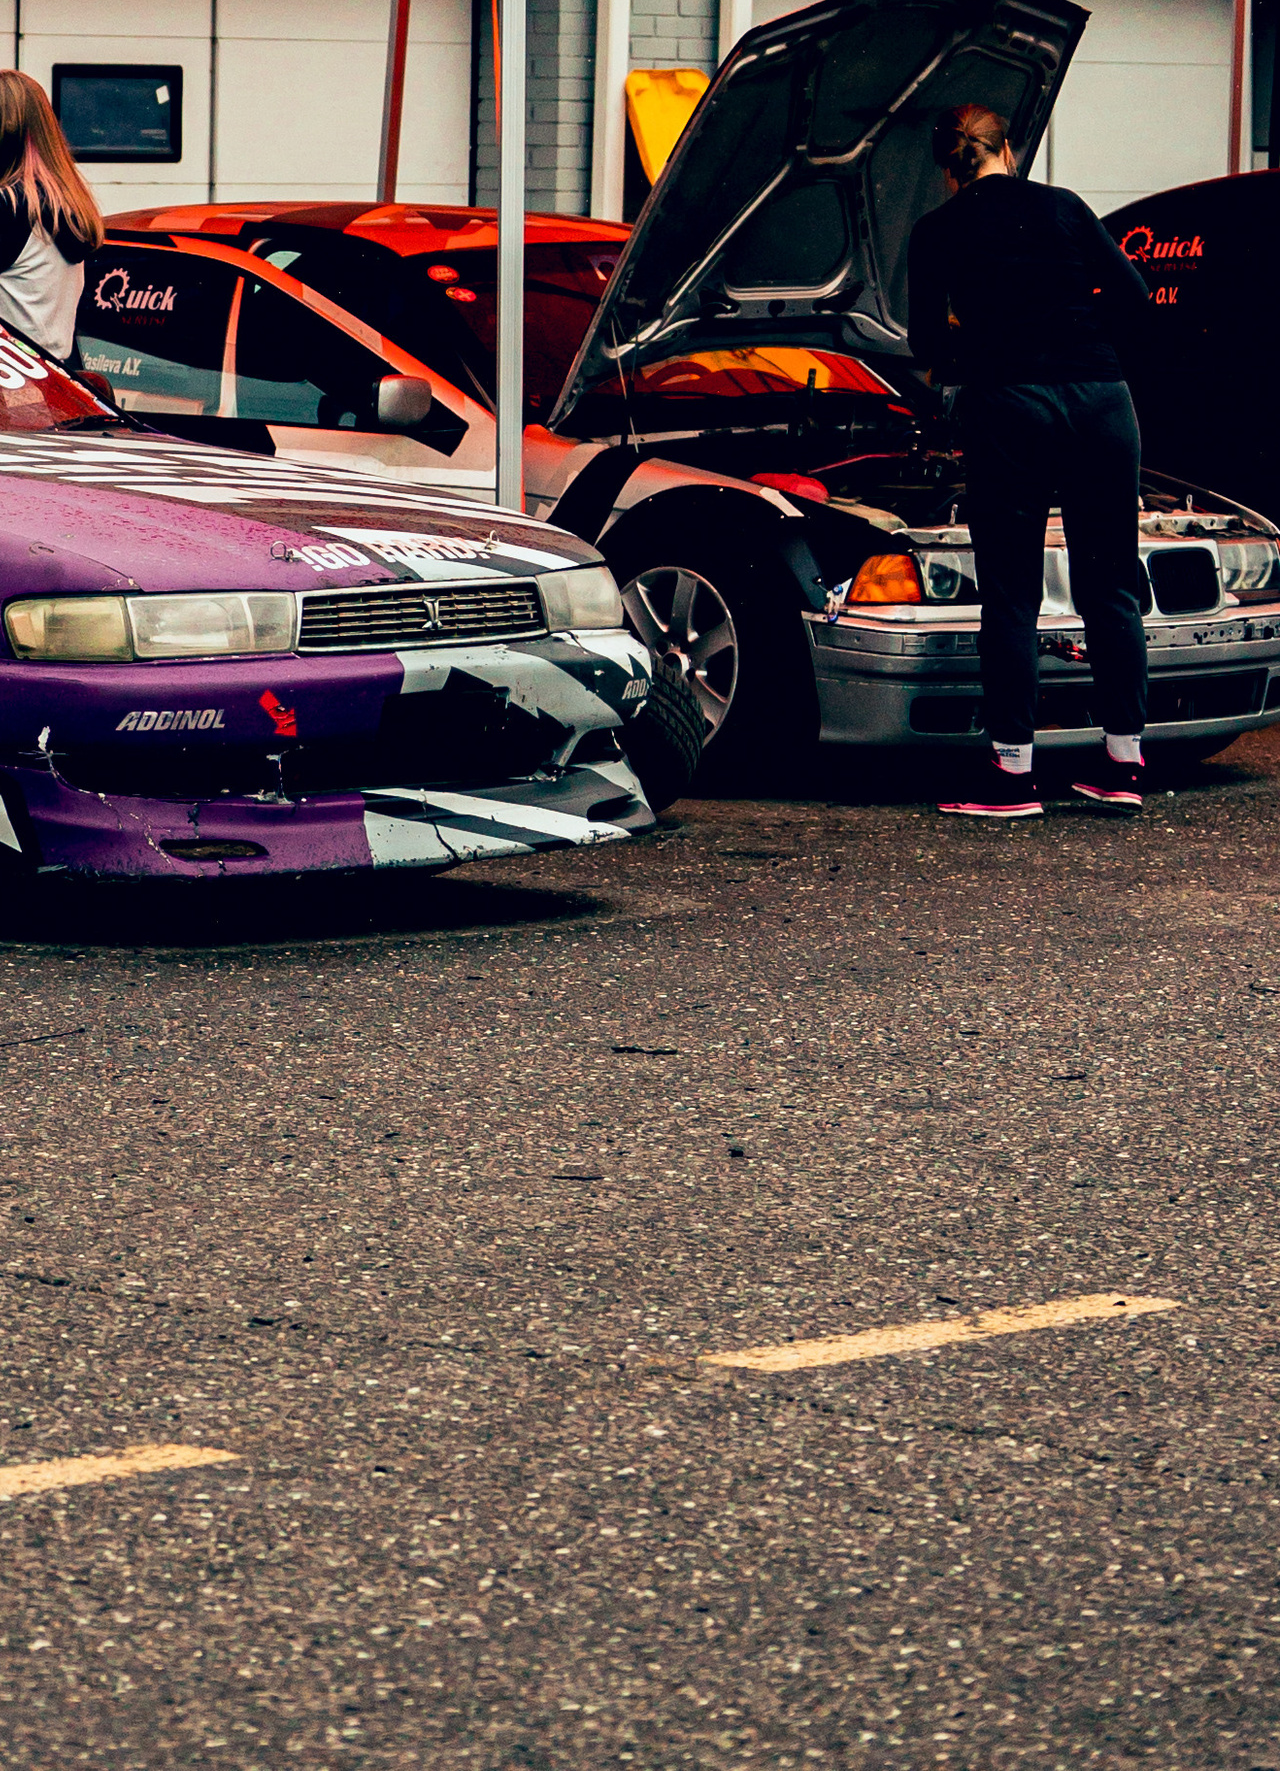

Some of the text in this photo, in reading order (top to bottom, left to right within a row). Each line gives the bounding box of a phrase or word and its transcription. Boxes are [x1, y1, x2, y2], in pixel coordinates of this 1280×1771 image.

[1118, 225, 1206, 263] Quick
[93, 267, 178, 313] Quick
[115, 708, 226, 731] ADDINOL
